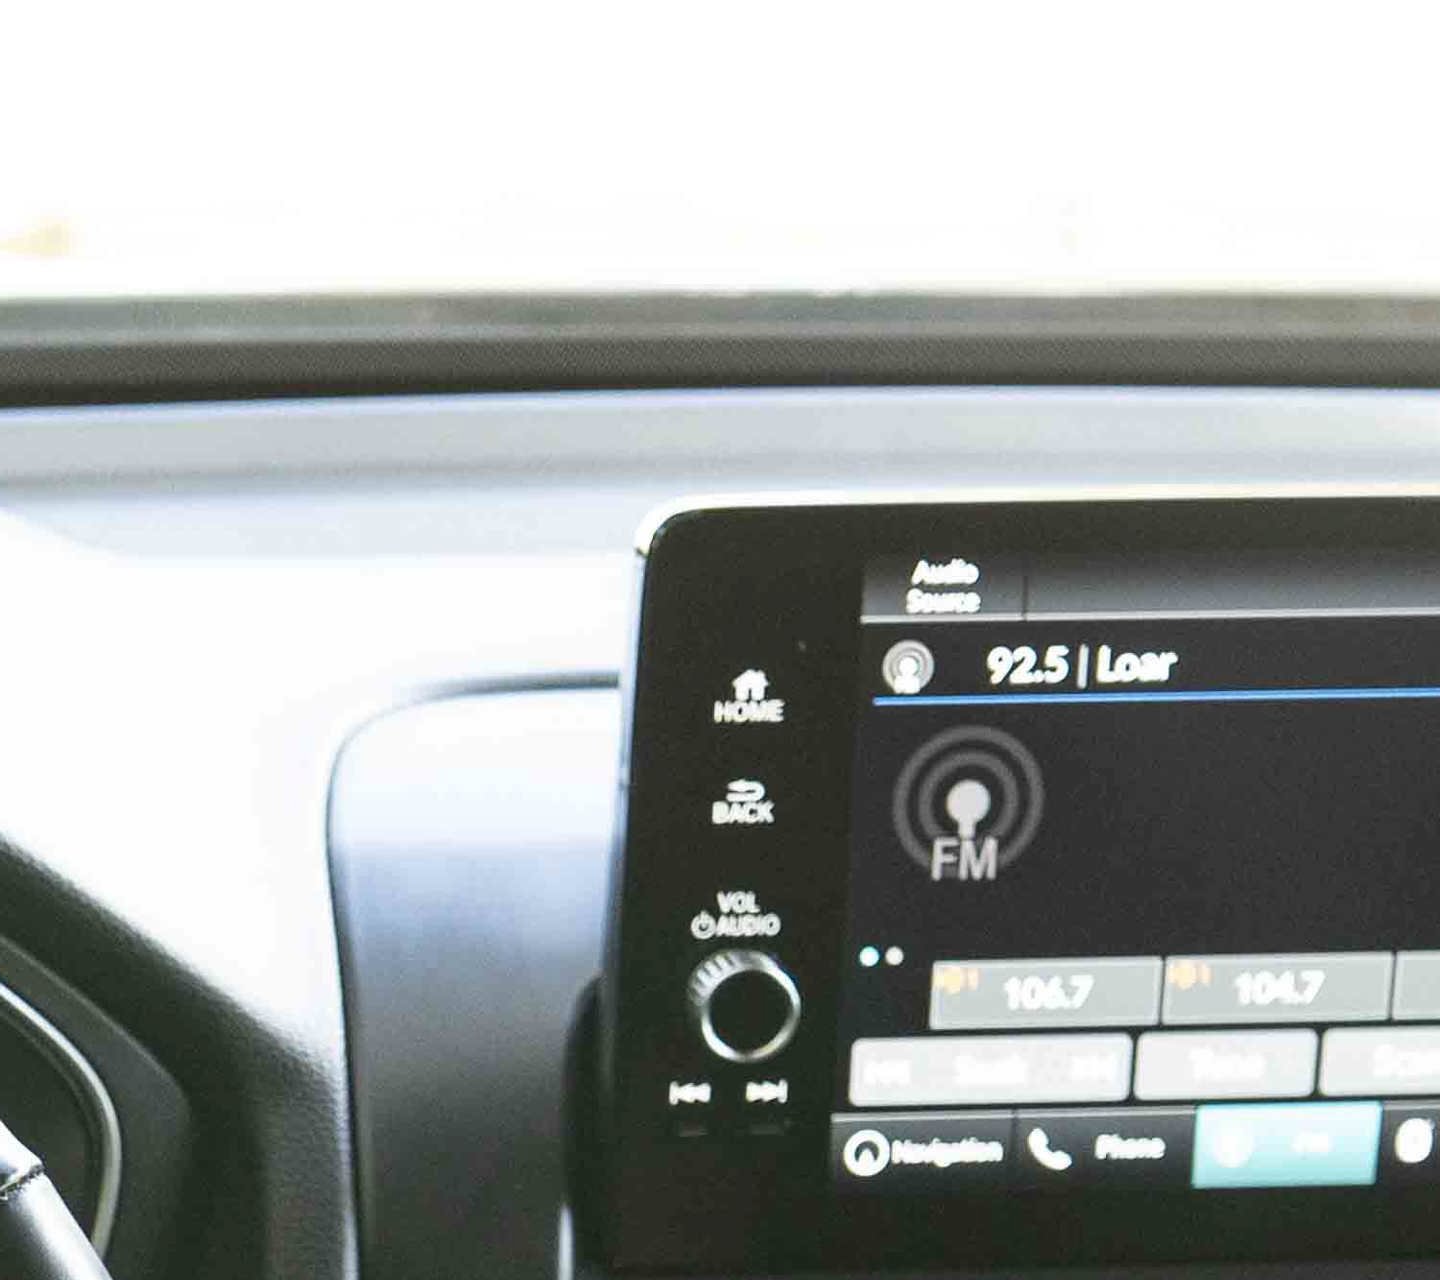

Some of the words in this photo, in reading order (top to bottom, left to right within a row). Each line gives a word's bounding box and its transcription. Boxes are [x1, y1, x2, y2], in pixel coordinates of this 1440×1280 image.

[911, 558, 980, 584] Audio
[906, 587, 982, 613] Source
[987, 645, 1070, 684] 92.5
[1096, 645, 1178, 682] Loar
[713, 702, 785, 723] HOME
[711, 801, 775, 824] BACK
[930, 837, 998, 881] FM
[717, 891, 760, 914] VOL
[715, 915, 781, 936] AUDIO
[1004, 974, 1095, 1010] 106.7
[1235, 970, 1326, 1007] 104.7
[891, 1137, 1004, 1167] Navigation
[1094, 1133, 1167, 1160] Phone
